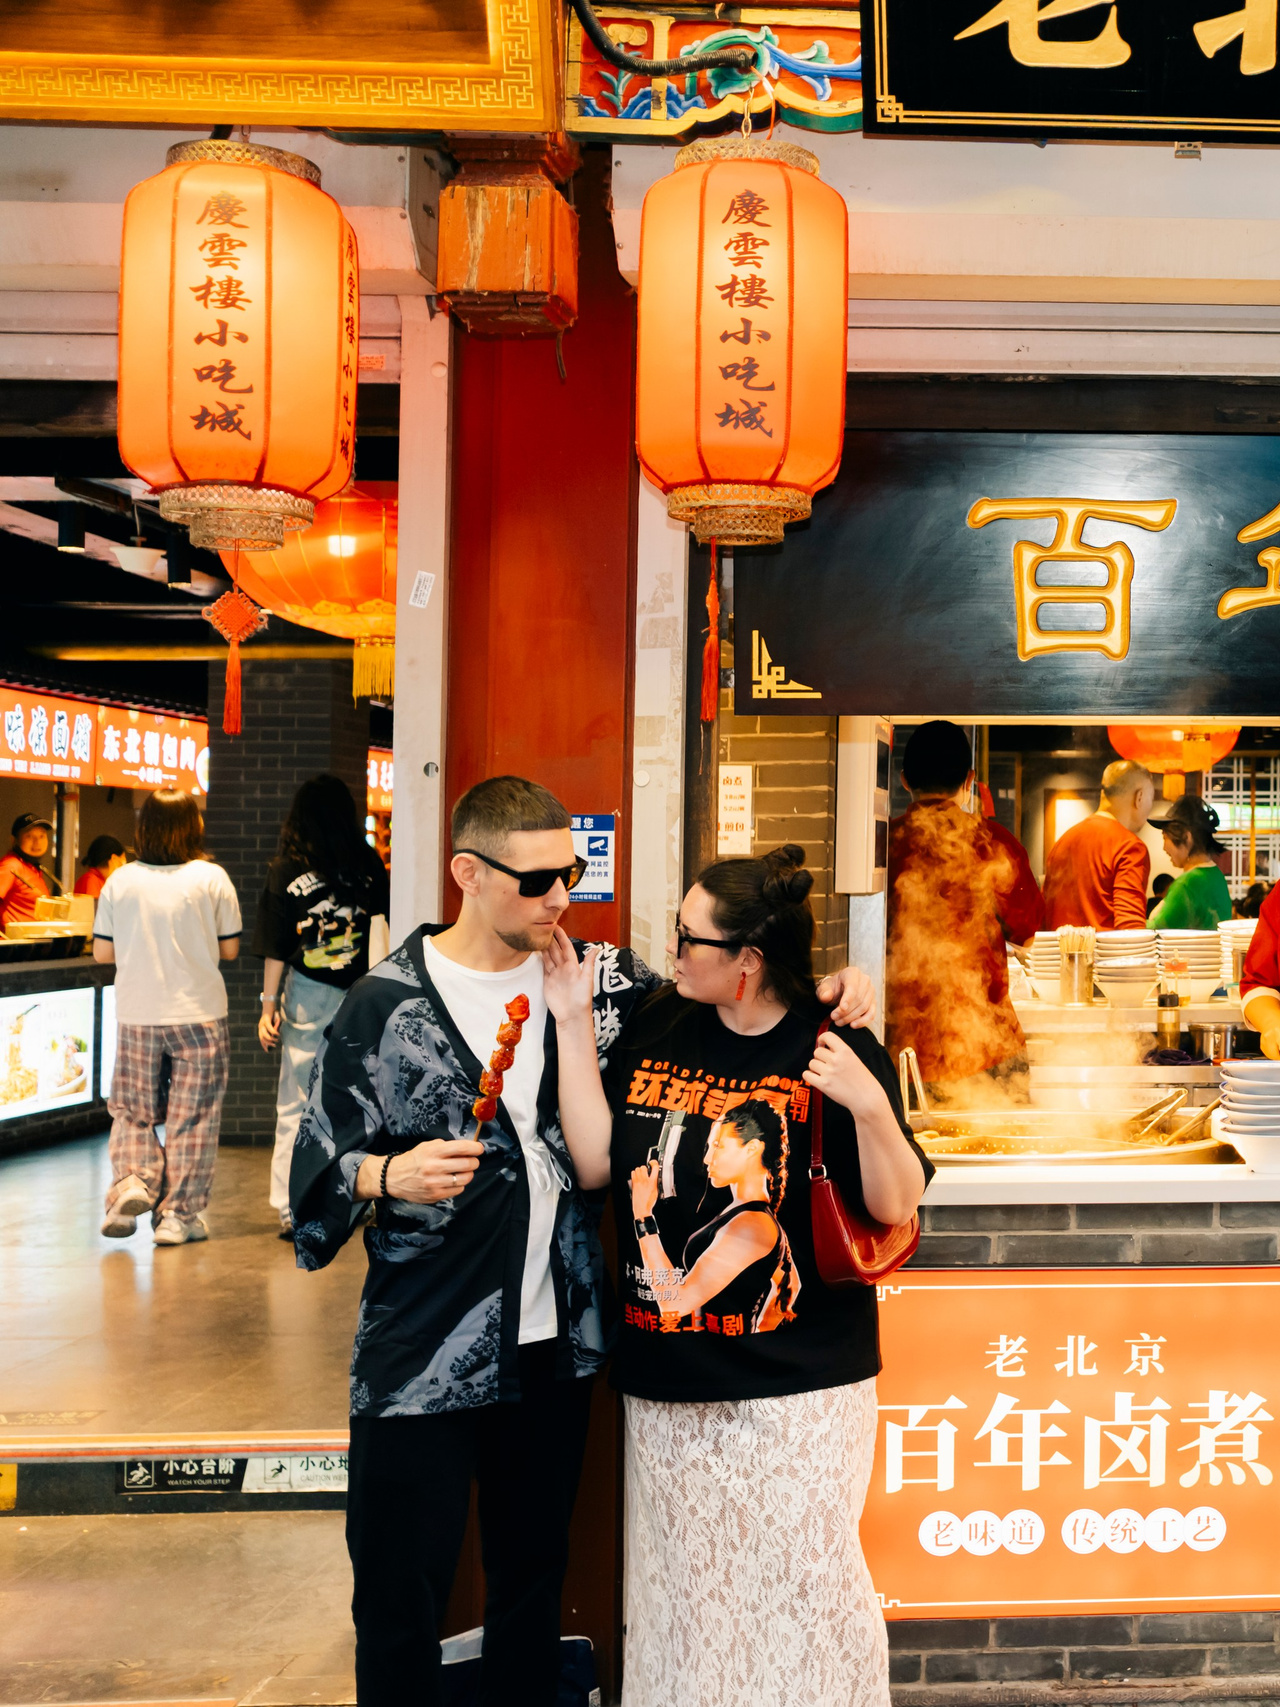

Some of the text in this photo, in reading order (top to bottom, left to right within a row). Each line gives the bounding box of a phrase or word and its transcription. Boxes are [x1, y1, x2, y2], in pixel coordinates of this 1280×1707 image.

[189, 190, 253, 440] 慶雲樓小吃城
[714, 189, 776, 439] 慶雲樓小吃城
[0, 704, 91, 763] 味凉面铺
[641, 1058, 690, 1078] WORLD
[984, 1333, 1168, 1377] 老北京
[163, 1458, 235, 1475] 小心台阶
[878, 1390, 1274, 1493] 百年卤煮
[931, 1513, 1219, 1547] 老味道 传统工艺
